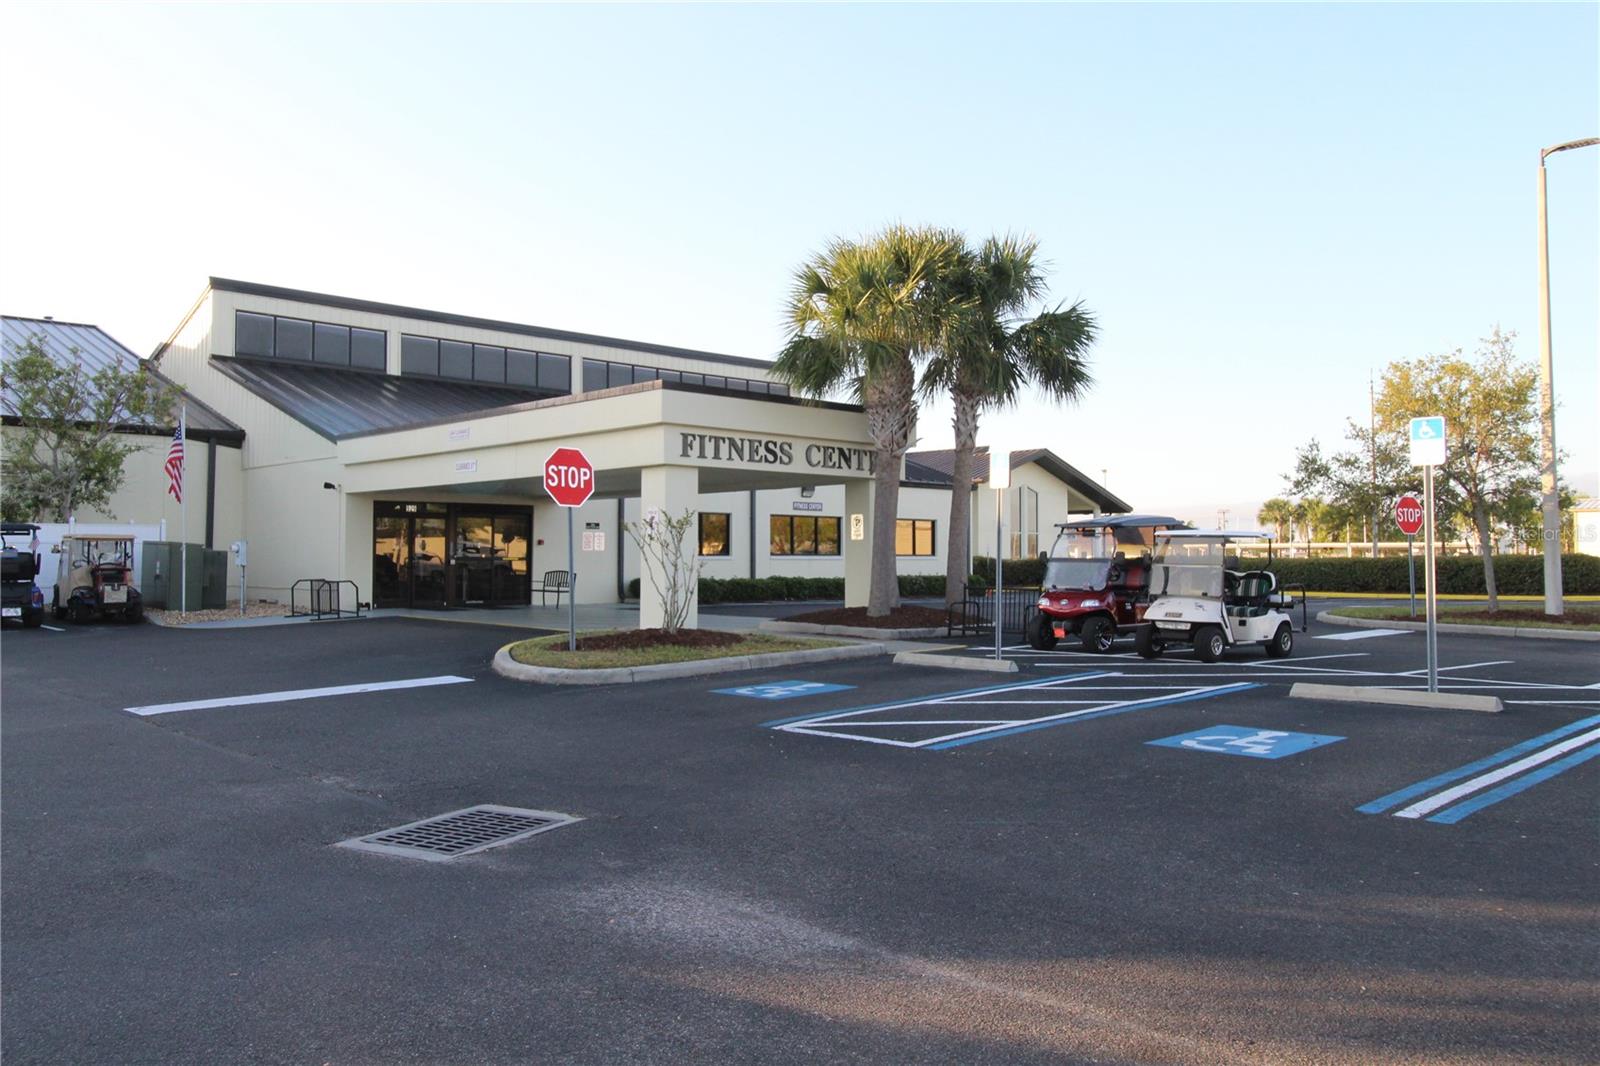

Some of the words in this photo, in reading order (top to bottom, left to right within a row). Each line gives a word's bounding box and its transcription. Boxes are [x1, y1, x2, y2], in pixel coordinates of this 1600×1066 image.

[680, 432, 793, 466] FITNESS
[805, 443, 877, 473] CENT
[547, 464, 590, 489] STOP
[1397, 508, 1421, 524] STOP
